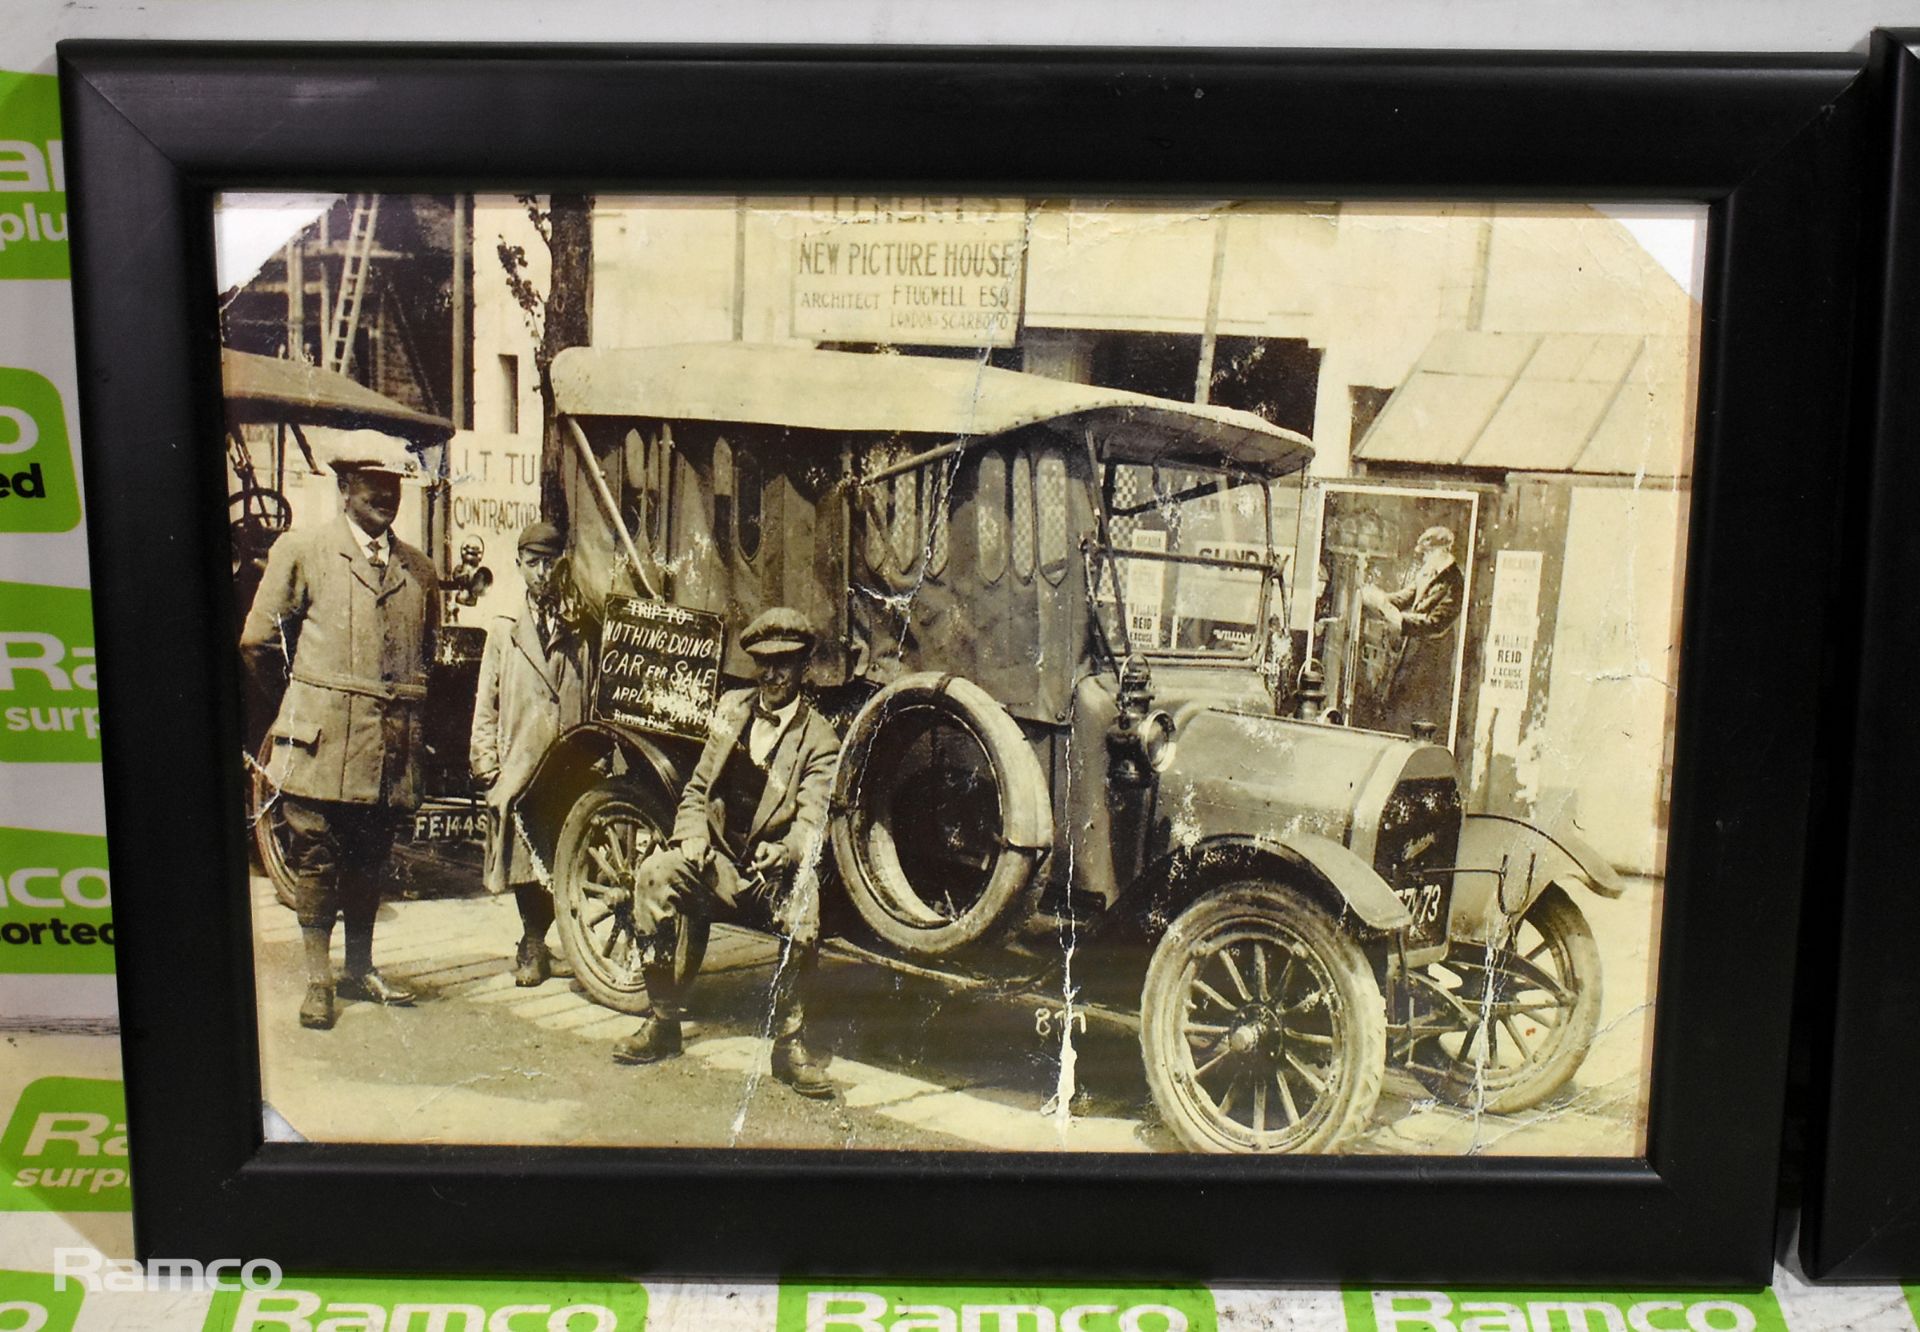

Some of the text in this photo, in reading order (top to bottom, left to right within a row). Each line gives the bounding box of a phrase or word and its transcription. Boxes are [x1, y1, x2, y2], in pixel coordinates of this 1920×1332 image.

[800, 242, 1015, 278] NEW PICTURE HOUSE
[801, 293, 881, 310] ARCHITECT
[1132, 616, 1153, 630] REID
[606, 620, 714, 658] NOTHING DOING
[602, 650, 718, 688] CAR FOR SALE
[1497, 649, 1522, 664] REID
